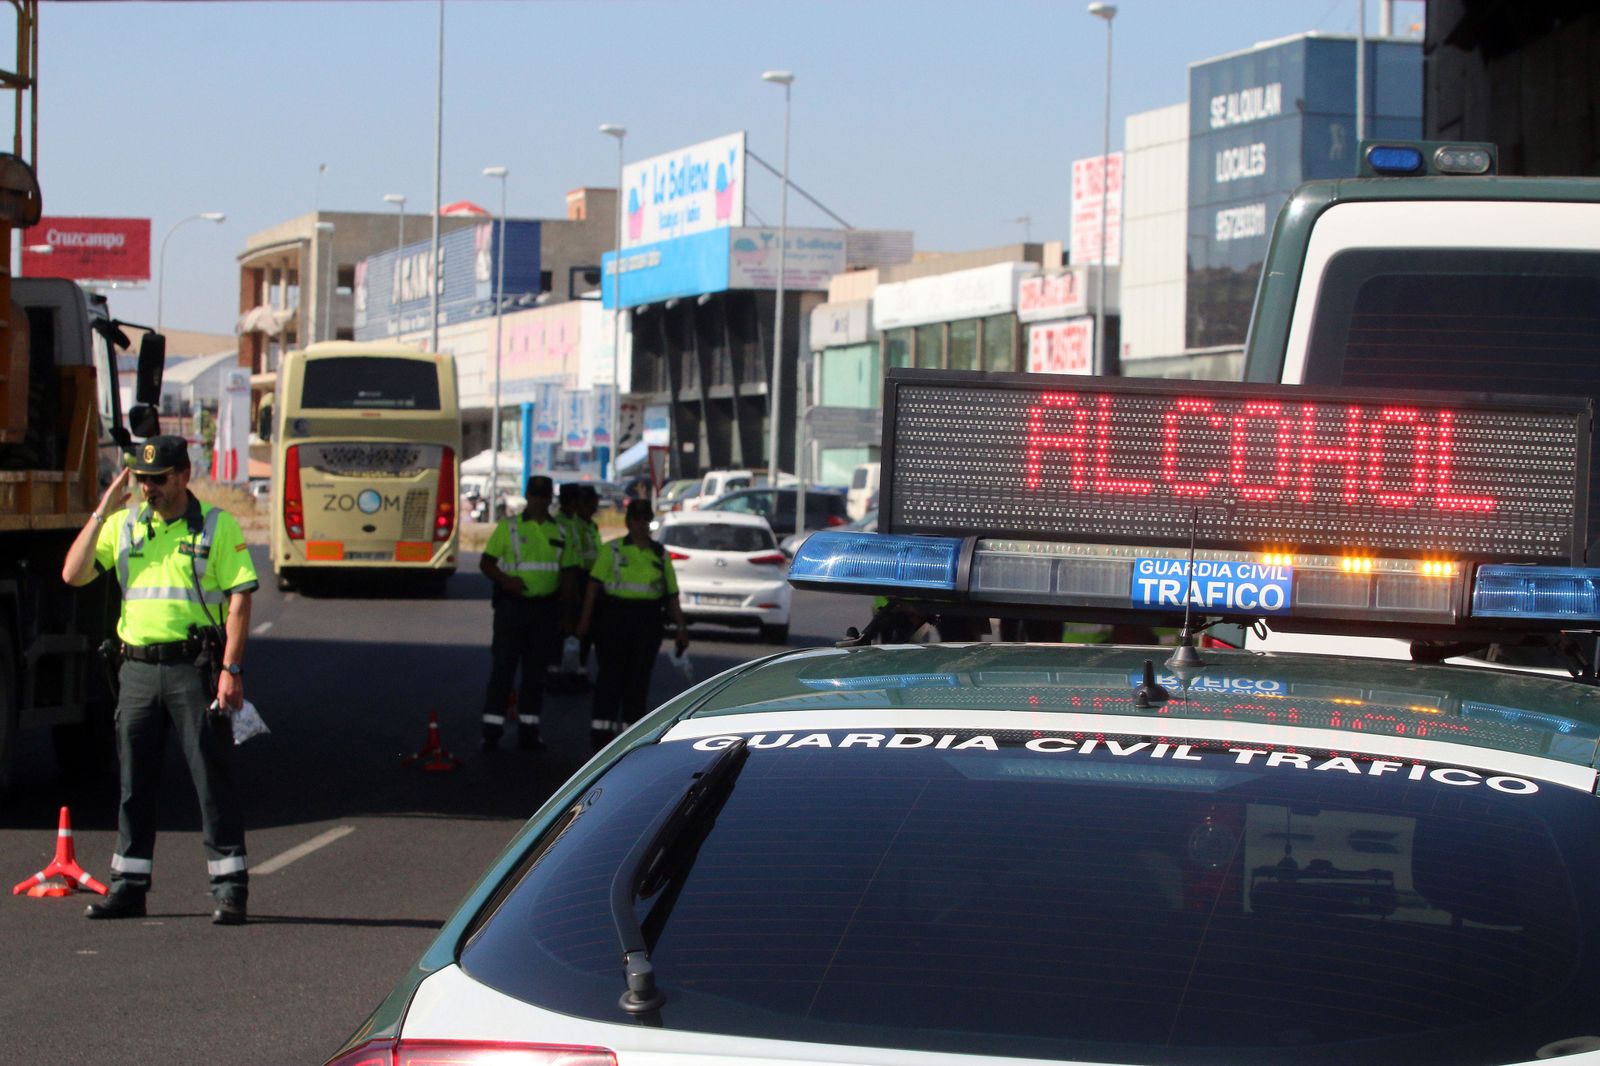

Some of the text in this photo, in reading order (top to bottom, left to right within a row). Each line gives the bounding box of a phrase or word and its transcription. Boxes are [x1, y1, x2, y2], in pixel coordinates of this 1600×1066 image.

[1210, 82, 1282, 128] SE ALQUILAN
[653, 154, 709, 205] La Ballena
[1215, 142, 1266, 183] LOCALES
[46, 228, 125, 250] Cruzcampo
[1026, 392, 1497, 510] ALCOHOL
[323, 488, 401, 515] ZOOM
[1139, 559, 1289, 581] GUARDIA CIVIL
[1138, 578, 1285, 611] TRAFICO
[692, 732, 1540, 795] GUARDIA CIVIL TRAFICO
